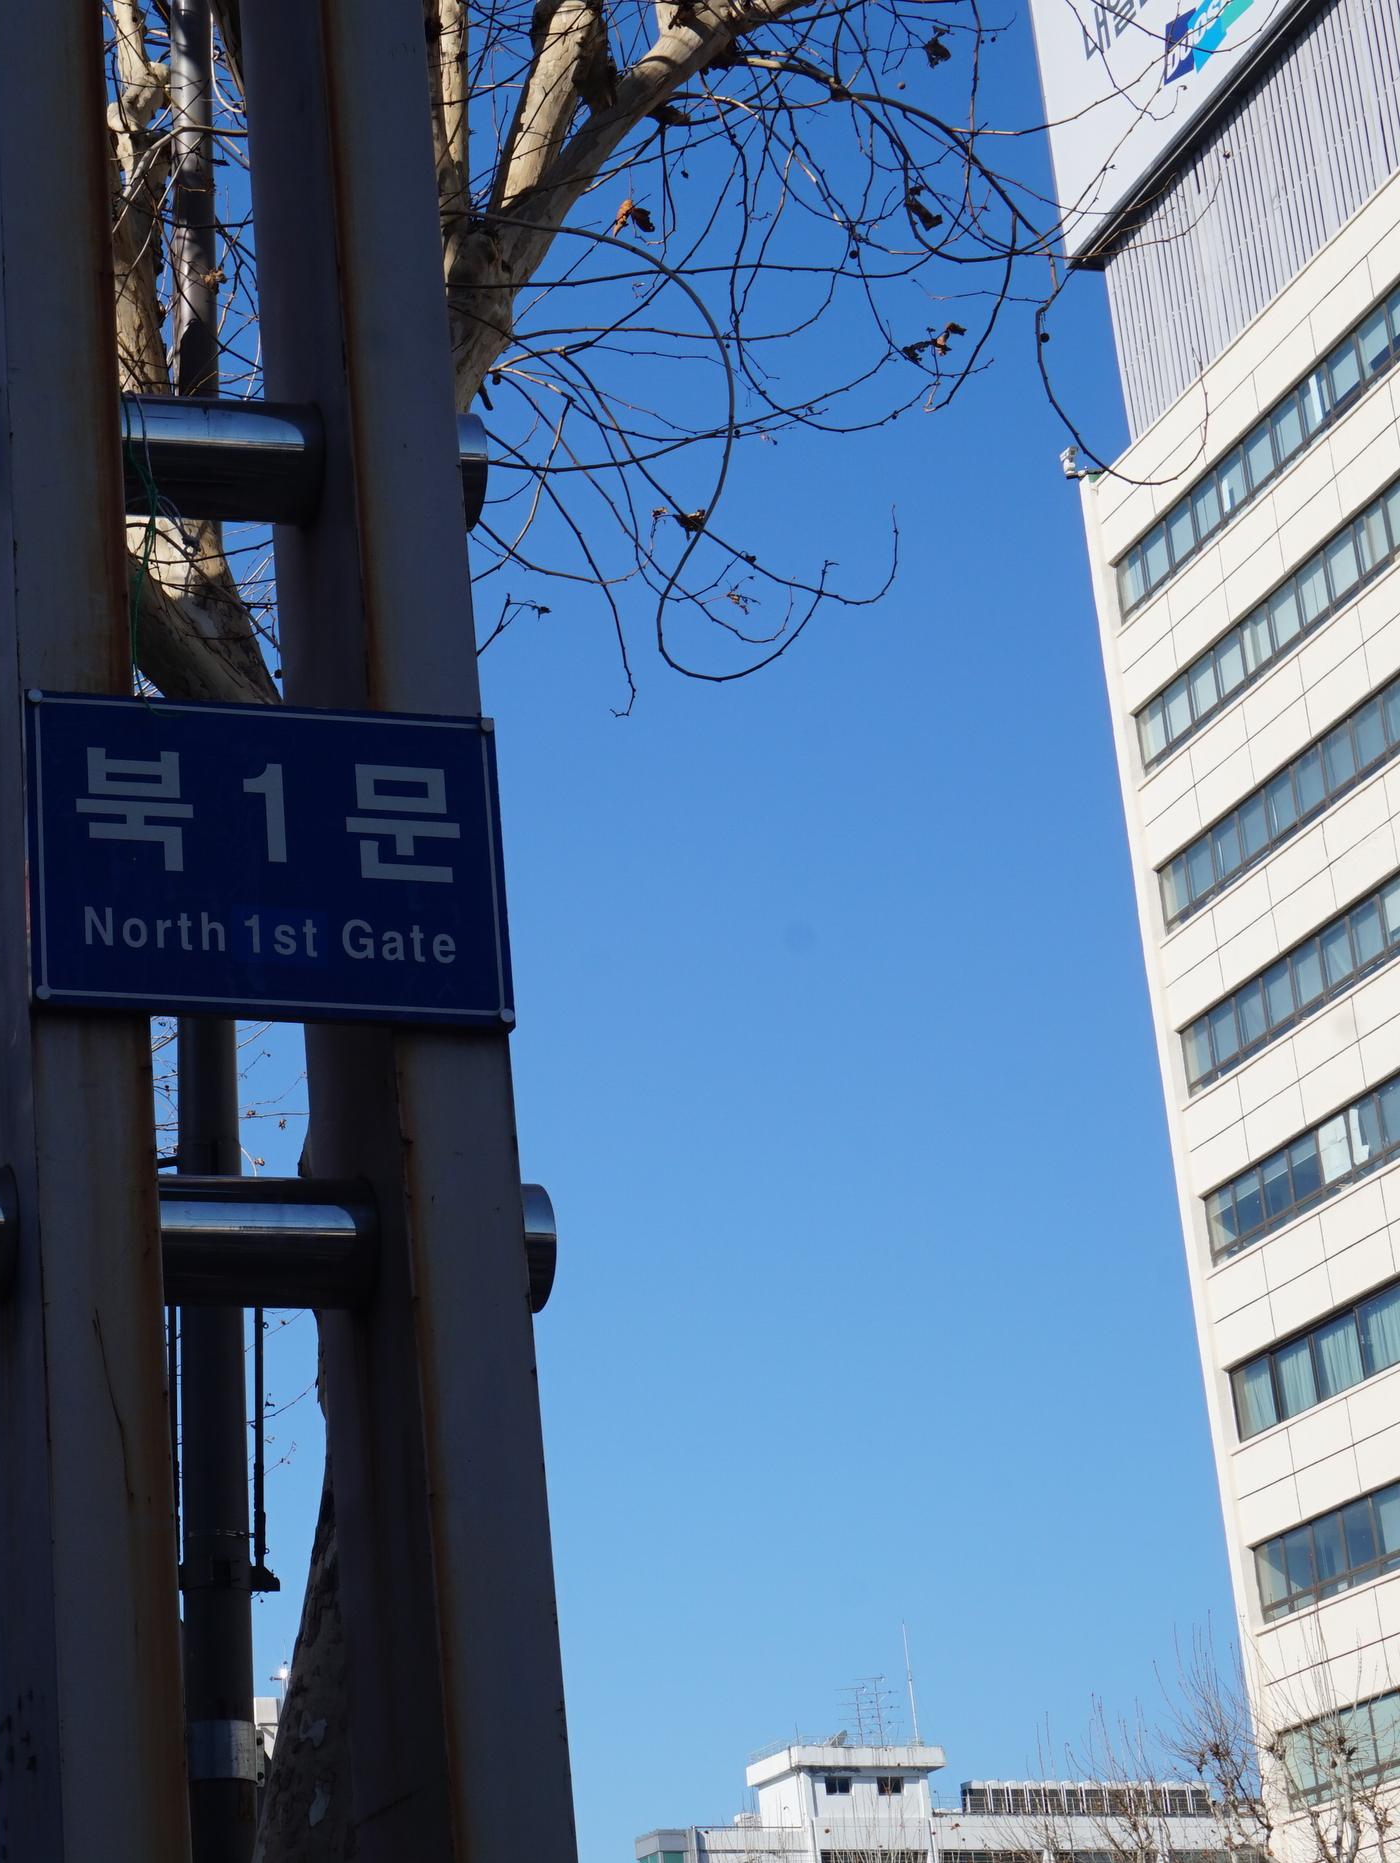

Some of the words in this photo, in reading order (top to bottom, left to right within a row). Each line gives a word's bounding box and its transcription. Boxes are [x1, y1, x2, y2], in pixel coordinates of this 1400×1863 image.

[84, 906, 226, 952] North
[245, 914, 319, 958] 1st
[342, 919, 457, 964] Gate
